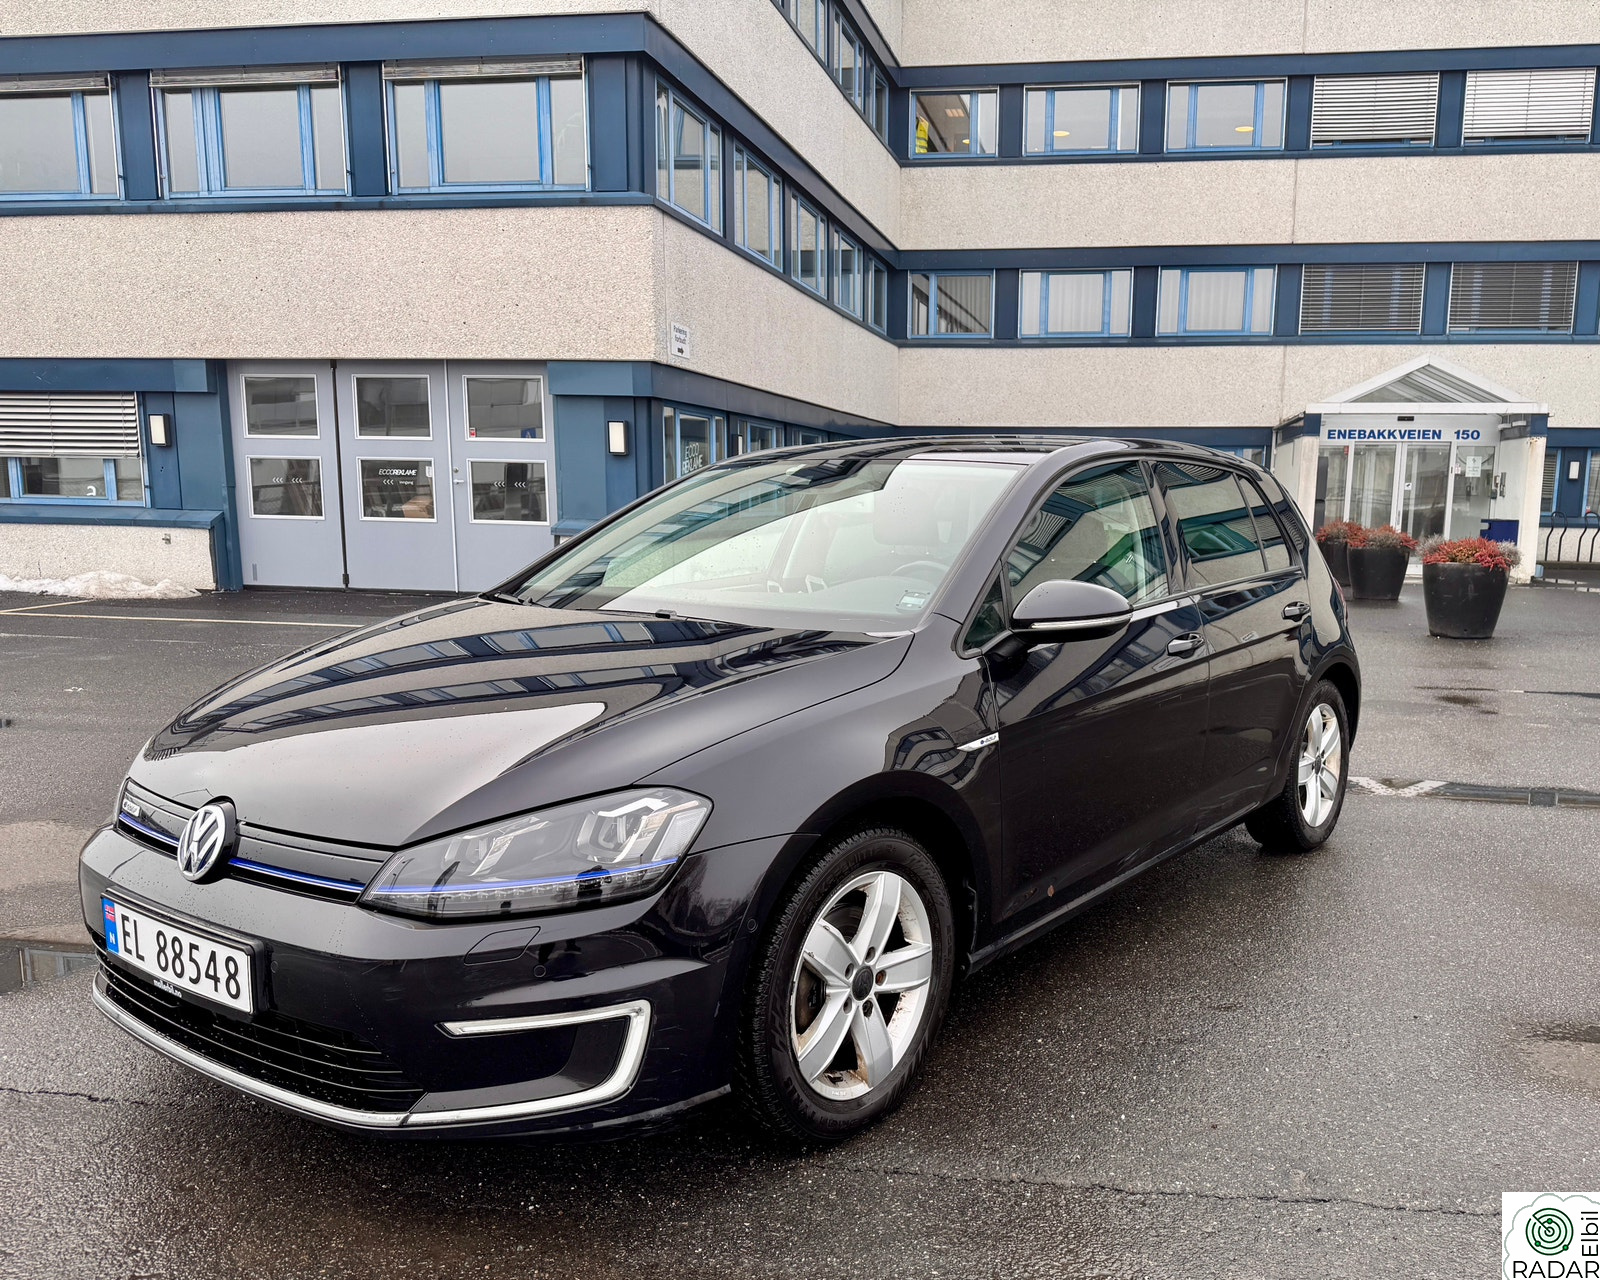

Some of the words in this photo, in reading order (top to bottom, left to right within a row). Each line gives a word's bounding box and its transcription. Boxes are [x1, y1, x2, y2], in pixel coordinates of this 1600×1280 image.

[1327, 429, 1442, 440] ENEBAKKVEIEN
[1453, 429, 1481, 440] 150
[109, 931, 116, 944] N
[120, 913, 145, 962] EL
[155, 929, 241, 1000] 88548
